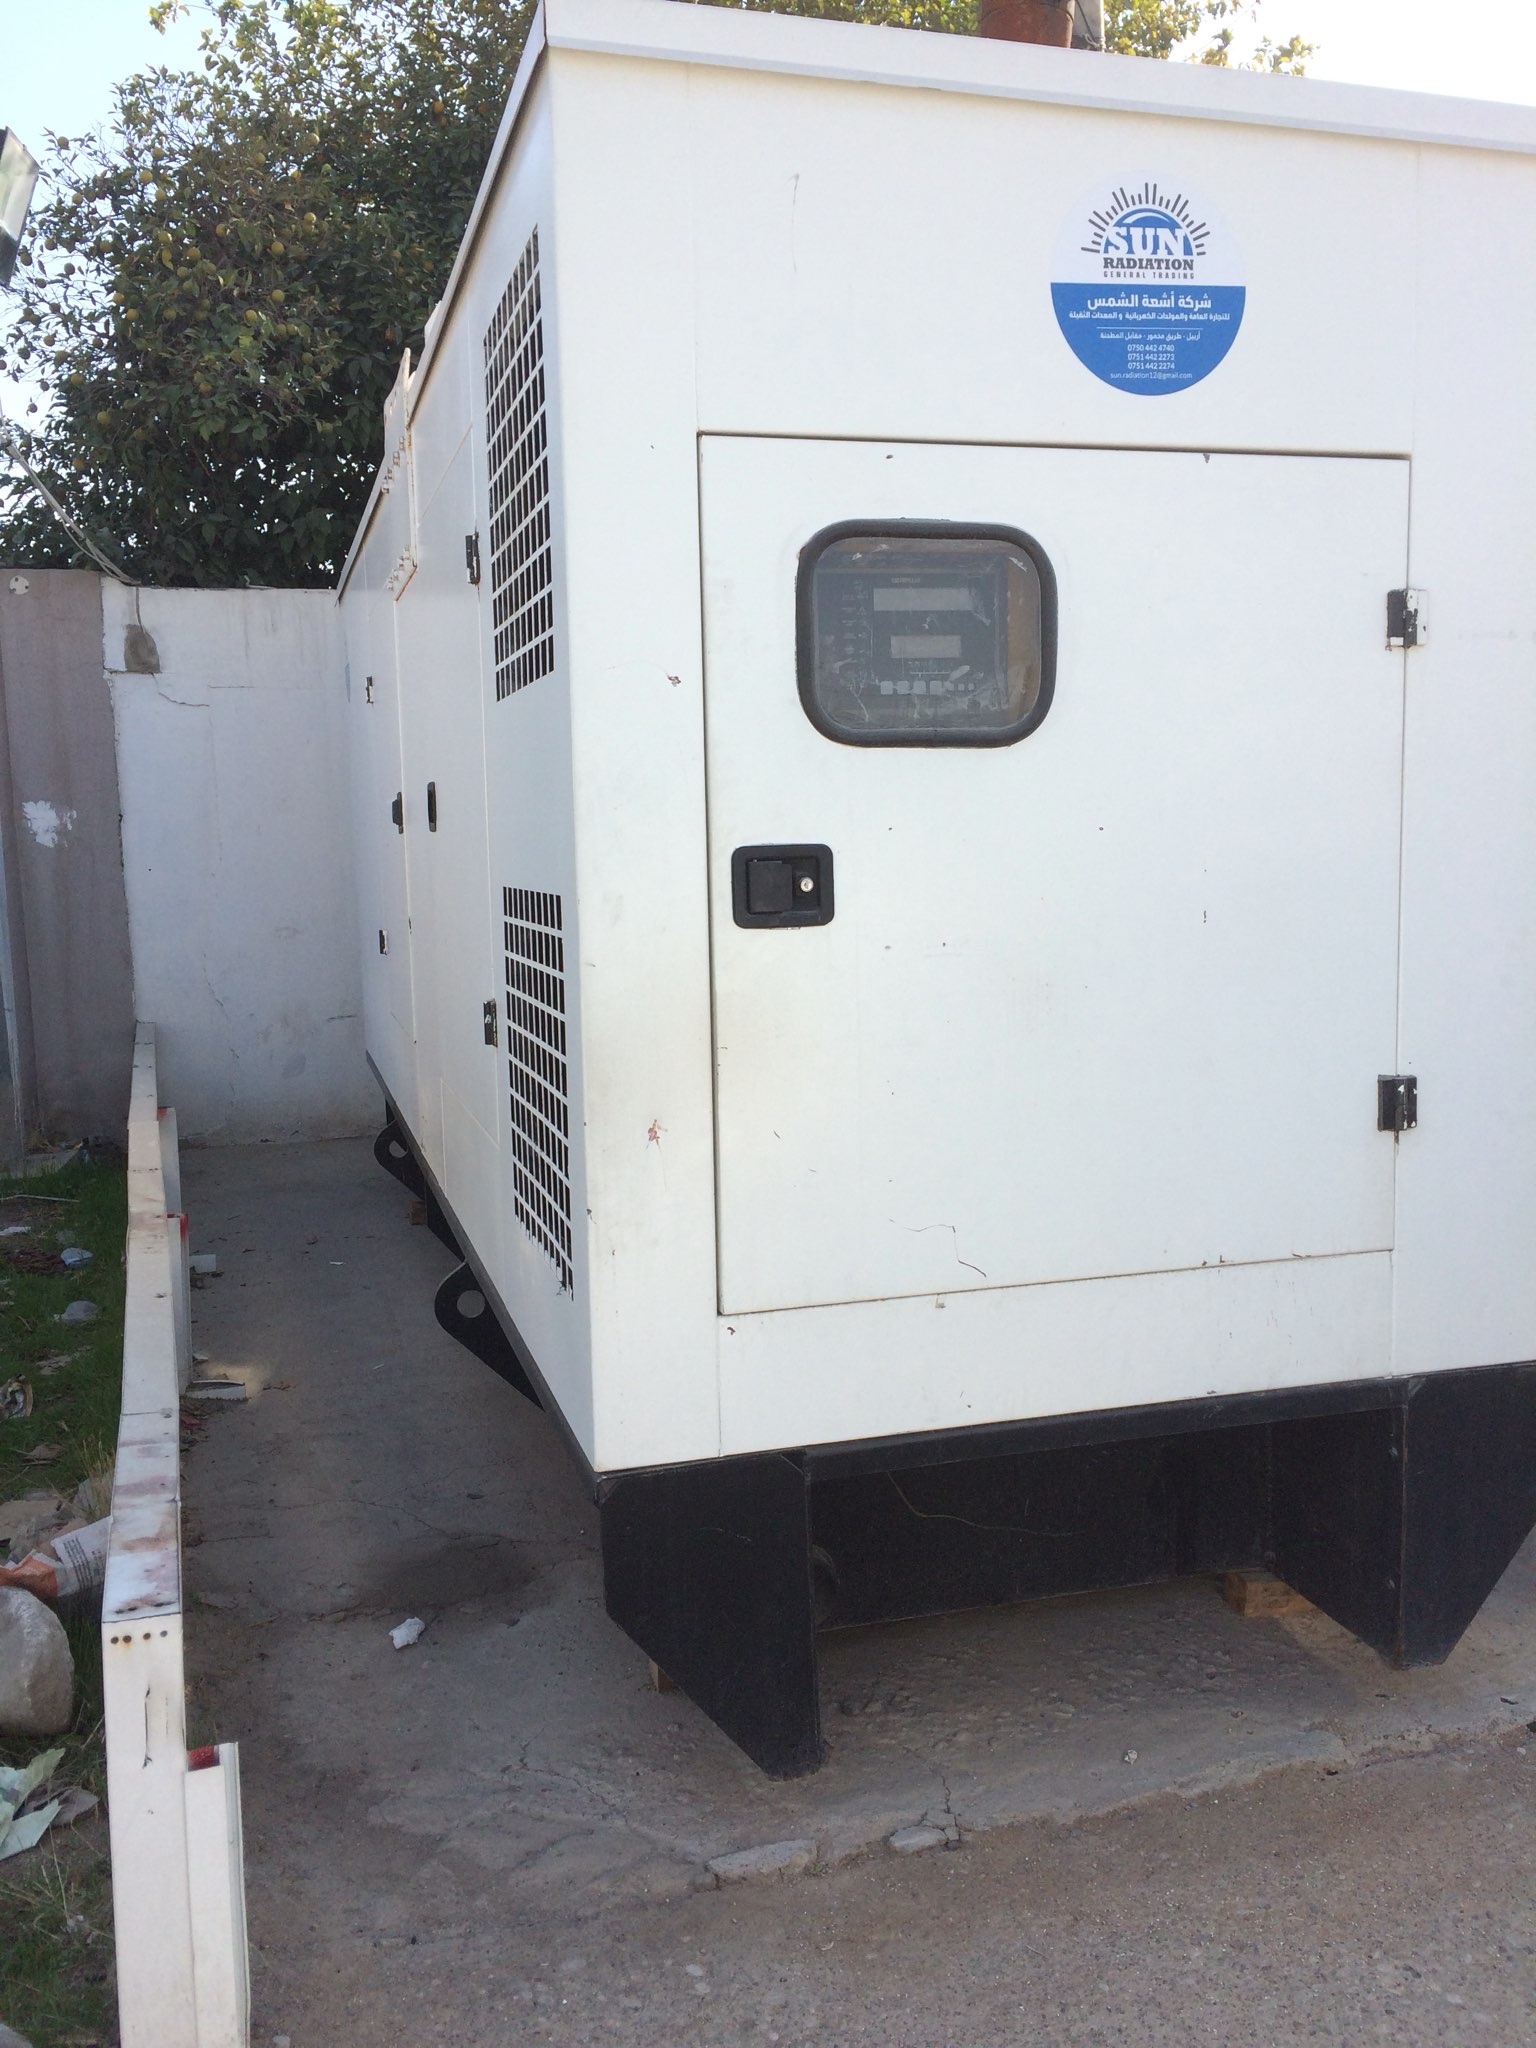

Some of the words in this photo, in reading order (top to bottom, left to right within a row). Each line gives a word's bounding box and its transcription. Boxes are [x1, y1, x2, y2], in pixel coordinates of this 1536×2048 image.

[1107, 226, 1185, 256] SUN
[1103, 257, 1194, 271] RADIATION
[1104, 271, 1146, 279] GENERAL
[1152, 271, 1194, 280] TRADING
[1087, 291, 1138, 311] الشمس
[1141, 291, 1174, 308] أشعة
[1178, 293, 1212, 312] شركة
[1091, 311, 1117, 320] المعدات
[1157, 312, 1188, 321] والمولدات
[1189, 312, 1208, 320] العامة
[1209, 313, 1231, 321] للتجارة
[1186, 331, 1201, 341] أربيل
[1127, 344, 1144, 352] 0750
[1145, 344, 1158, 352] 442
[1158, 344, 1175, 352] 4740
[1127, 353, 1144, 361] 0751
[1145, 353, 1158, 361] 442
[1158, 353, 1175, 361] 2273
[1127, 362, 1144, 370] 0751
[1145, 362, 1158, 370] 442
[1158, 362, 1175, 370] 2274
[1110, 371, 1193, 380] sun.radiation12@gmail.com
